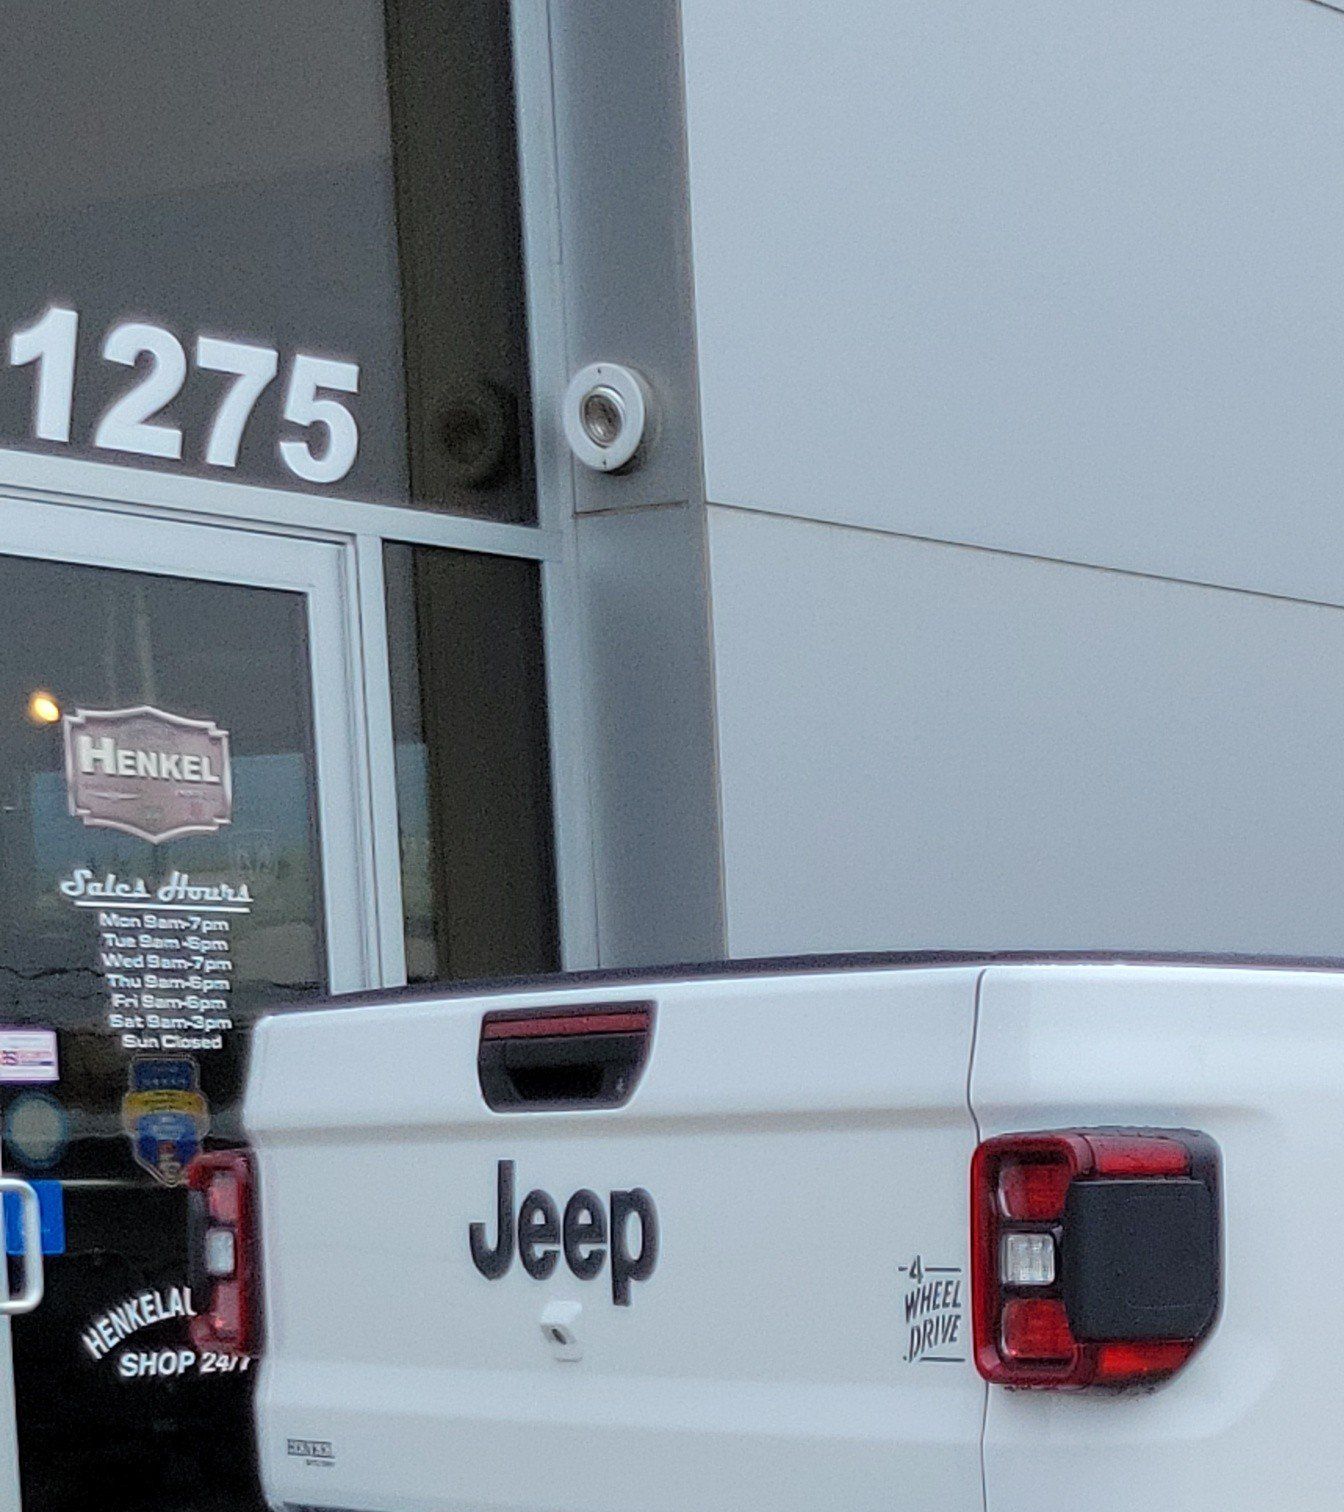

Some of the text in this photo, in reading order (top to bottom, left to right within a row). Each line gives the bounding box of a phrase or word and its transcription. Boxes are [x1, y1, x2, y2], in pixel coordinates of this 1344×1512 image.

[10, 307, 360, 484] 1275
[78, 735, 221, 784] HENKEL
[60, 869, 253, 902] Sales Hours
[101, 912, 141, 929] Mon
[102, 933, 136, 949] Tue
[101, 953, 144, 969] Wed
[105, 973, 142, 989] Thu
[112, 994, 139, 1009] Fri
[109, 1014, 144, 1029] Sat
[121, 1034, 222, 1050] Sun Closed
[468, 1159, 660, 1306] Jeep
[909, 1255, 923, 1284] 4
[905, 1280, 961, 1323] WHEEL
[908, 1315, 961, 1363] DRIVE
[119, 1351, 195, 1378] SHOP
